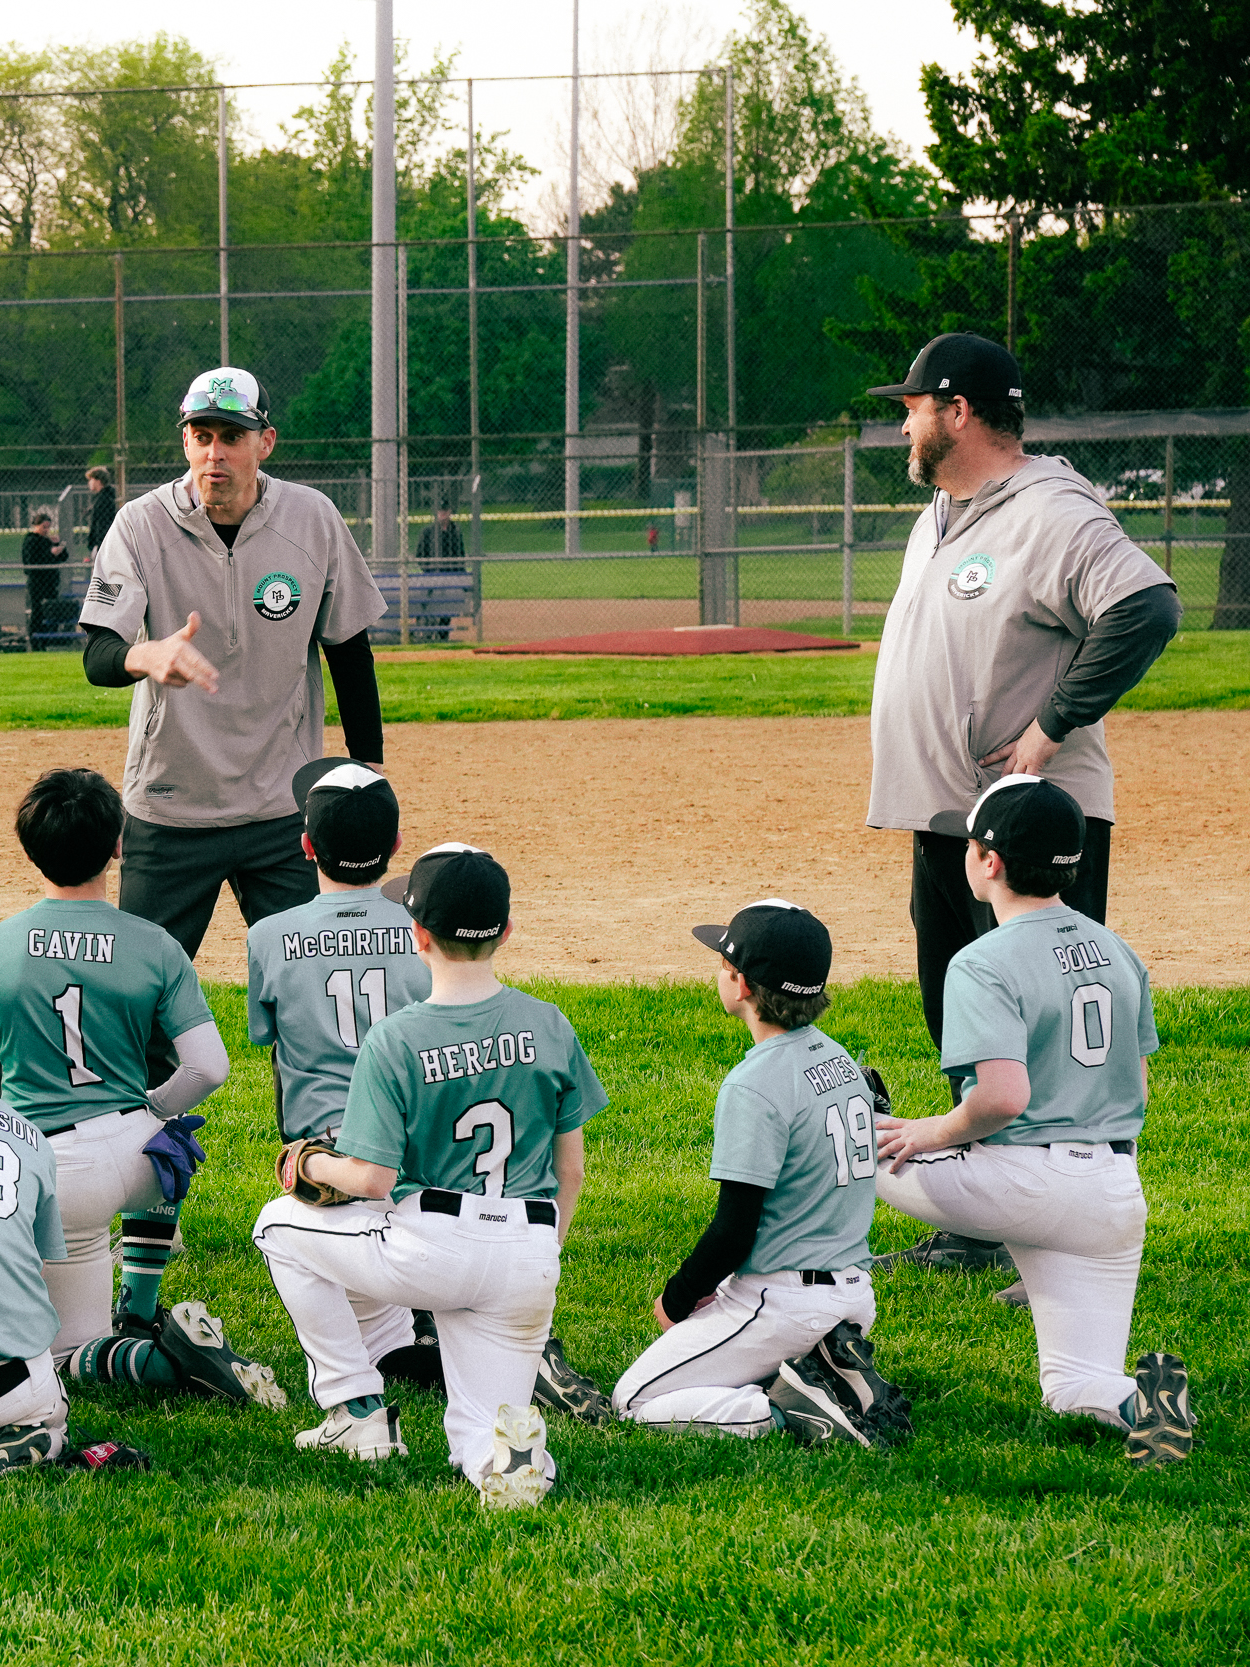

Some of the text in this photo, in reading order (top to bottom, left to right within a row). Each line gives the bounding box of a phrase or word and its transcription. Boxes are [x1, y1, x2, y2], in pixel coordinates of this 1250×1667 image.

[256, 573, 299, 594] MOUNT PROSPECT
[338, 855, 382, 869] marucci
[337, 910, 368, 919] marucci
[455, 923, 501, 938] marucci
[28, 928, 115, 964] GAVIN
[1052, 940, 1111, 975] BOLL
[781, 981, 825, 995] marucci
[325, 967, 388, 1048] 11
[1070, 981, 1113, 1068] 0
[52, 983, 106, 1088] 1
[419, 1031, 537, 1084] HERZOG
[804, 1055, 859, 1096] HAYES
[452, 1098, 514, 1198] 3
[825, 1094, 876, 1187] 19
[478, 1211, 508, 1223] marucci
